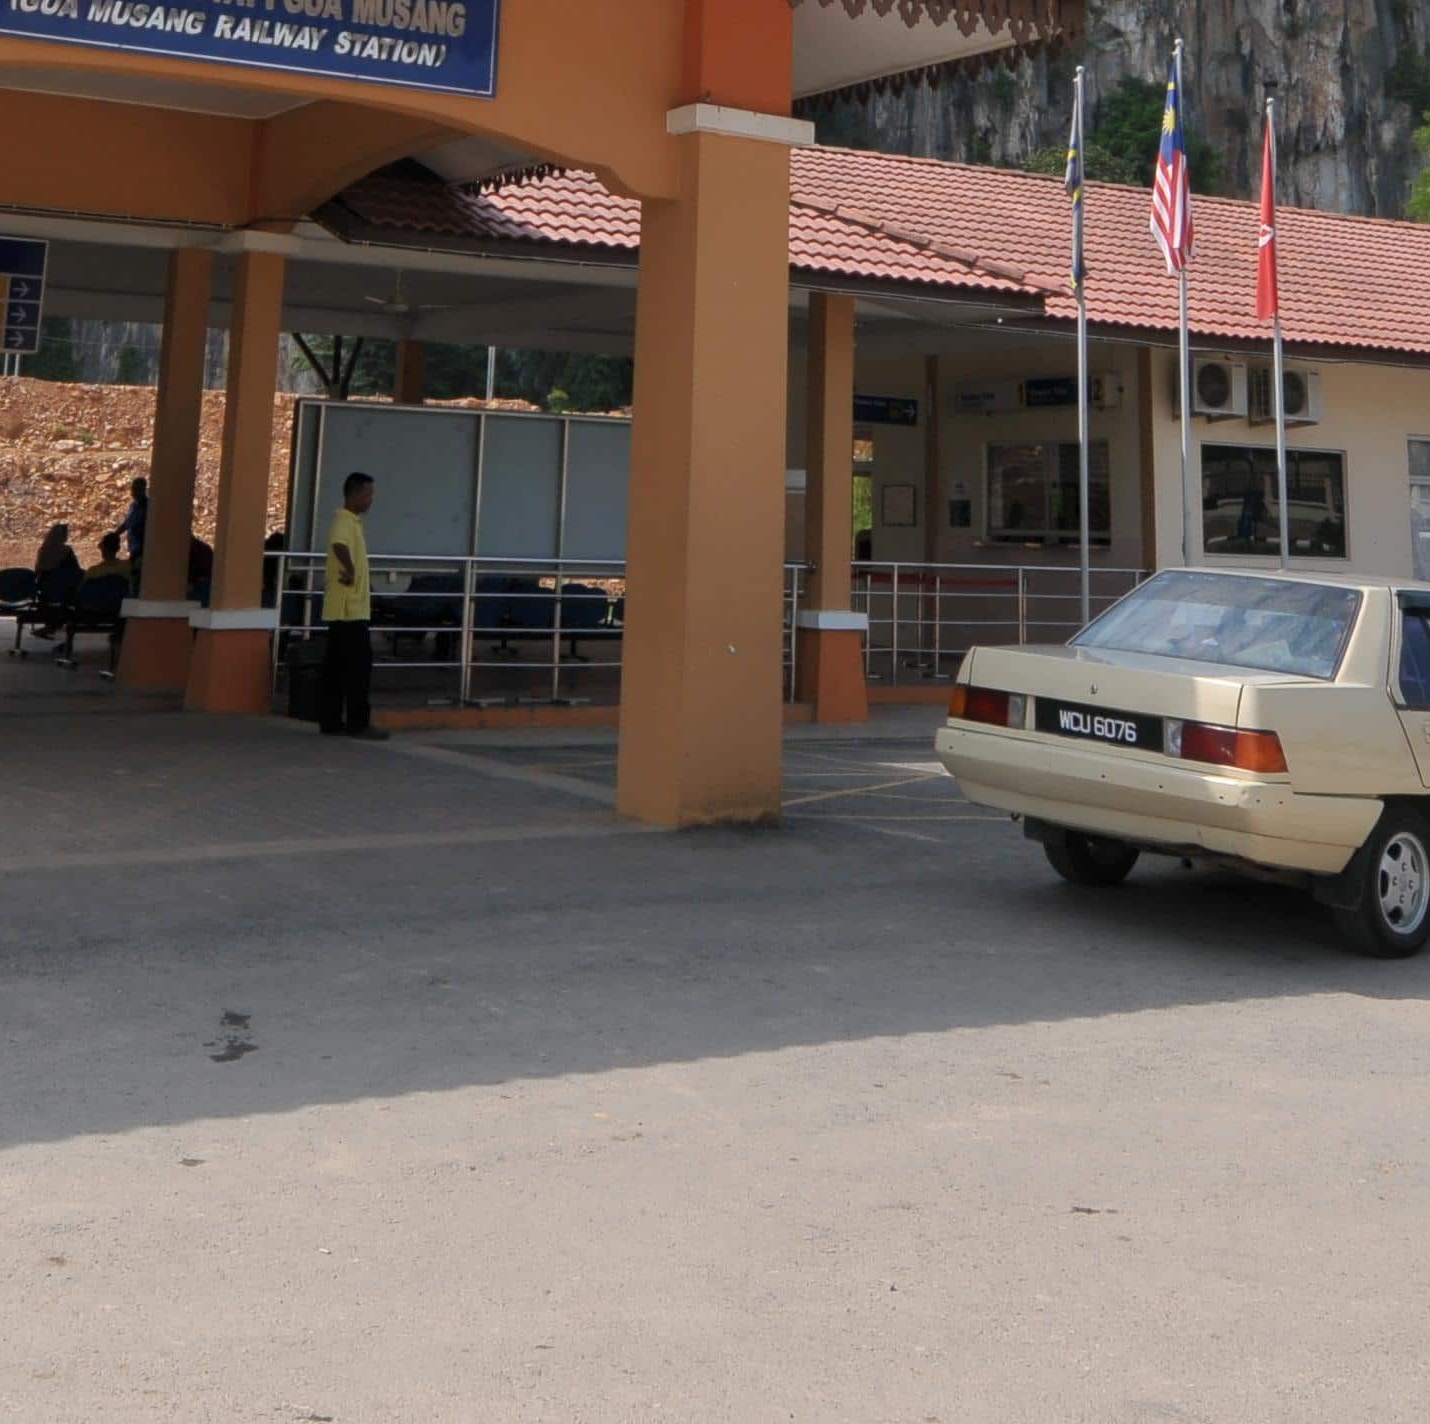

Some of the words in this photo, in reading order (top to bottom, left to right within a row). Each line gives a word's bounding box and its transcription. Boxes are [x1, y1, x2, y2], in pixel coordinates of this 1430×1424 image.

[214, 14, 328, 51] RAILWAY
[334, 31, 447, 67] STATION)
[1059, 709, 1091, 733] WCU
[1094, 716, 1137, 743] 6076
